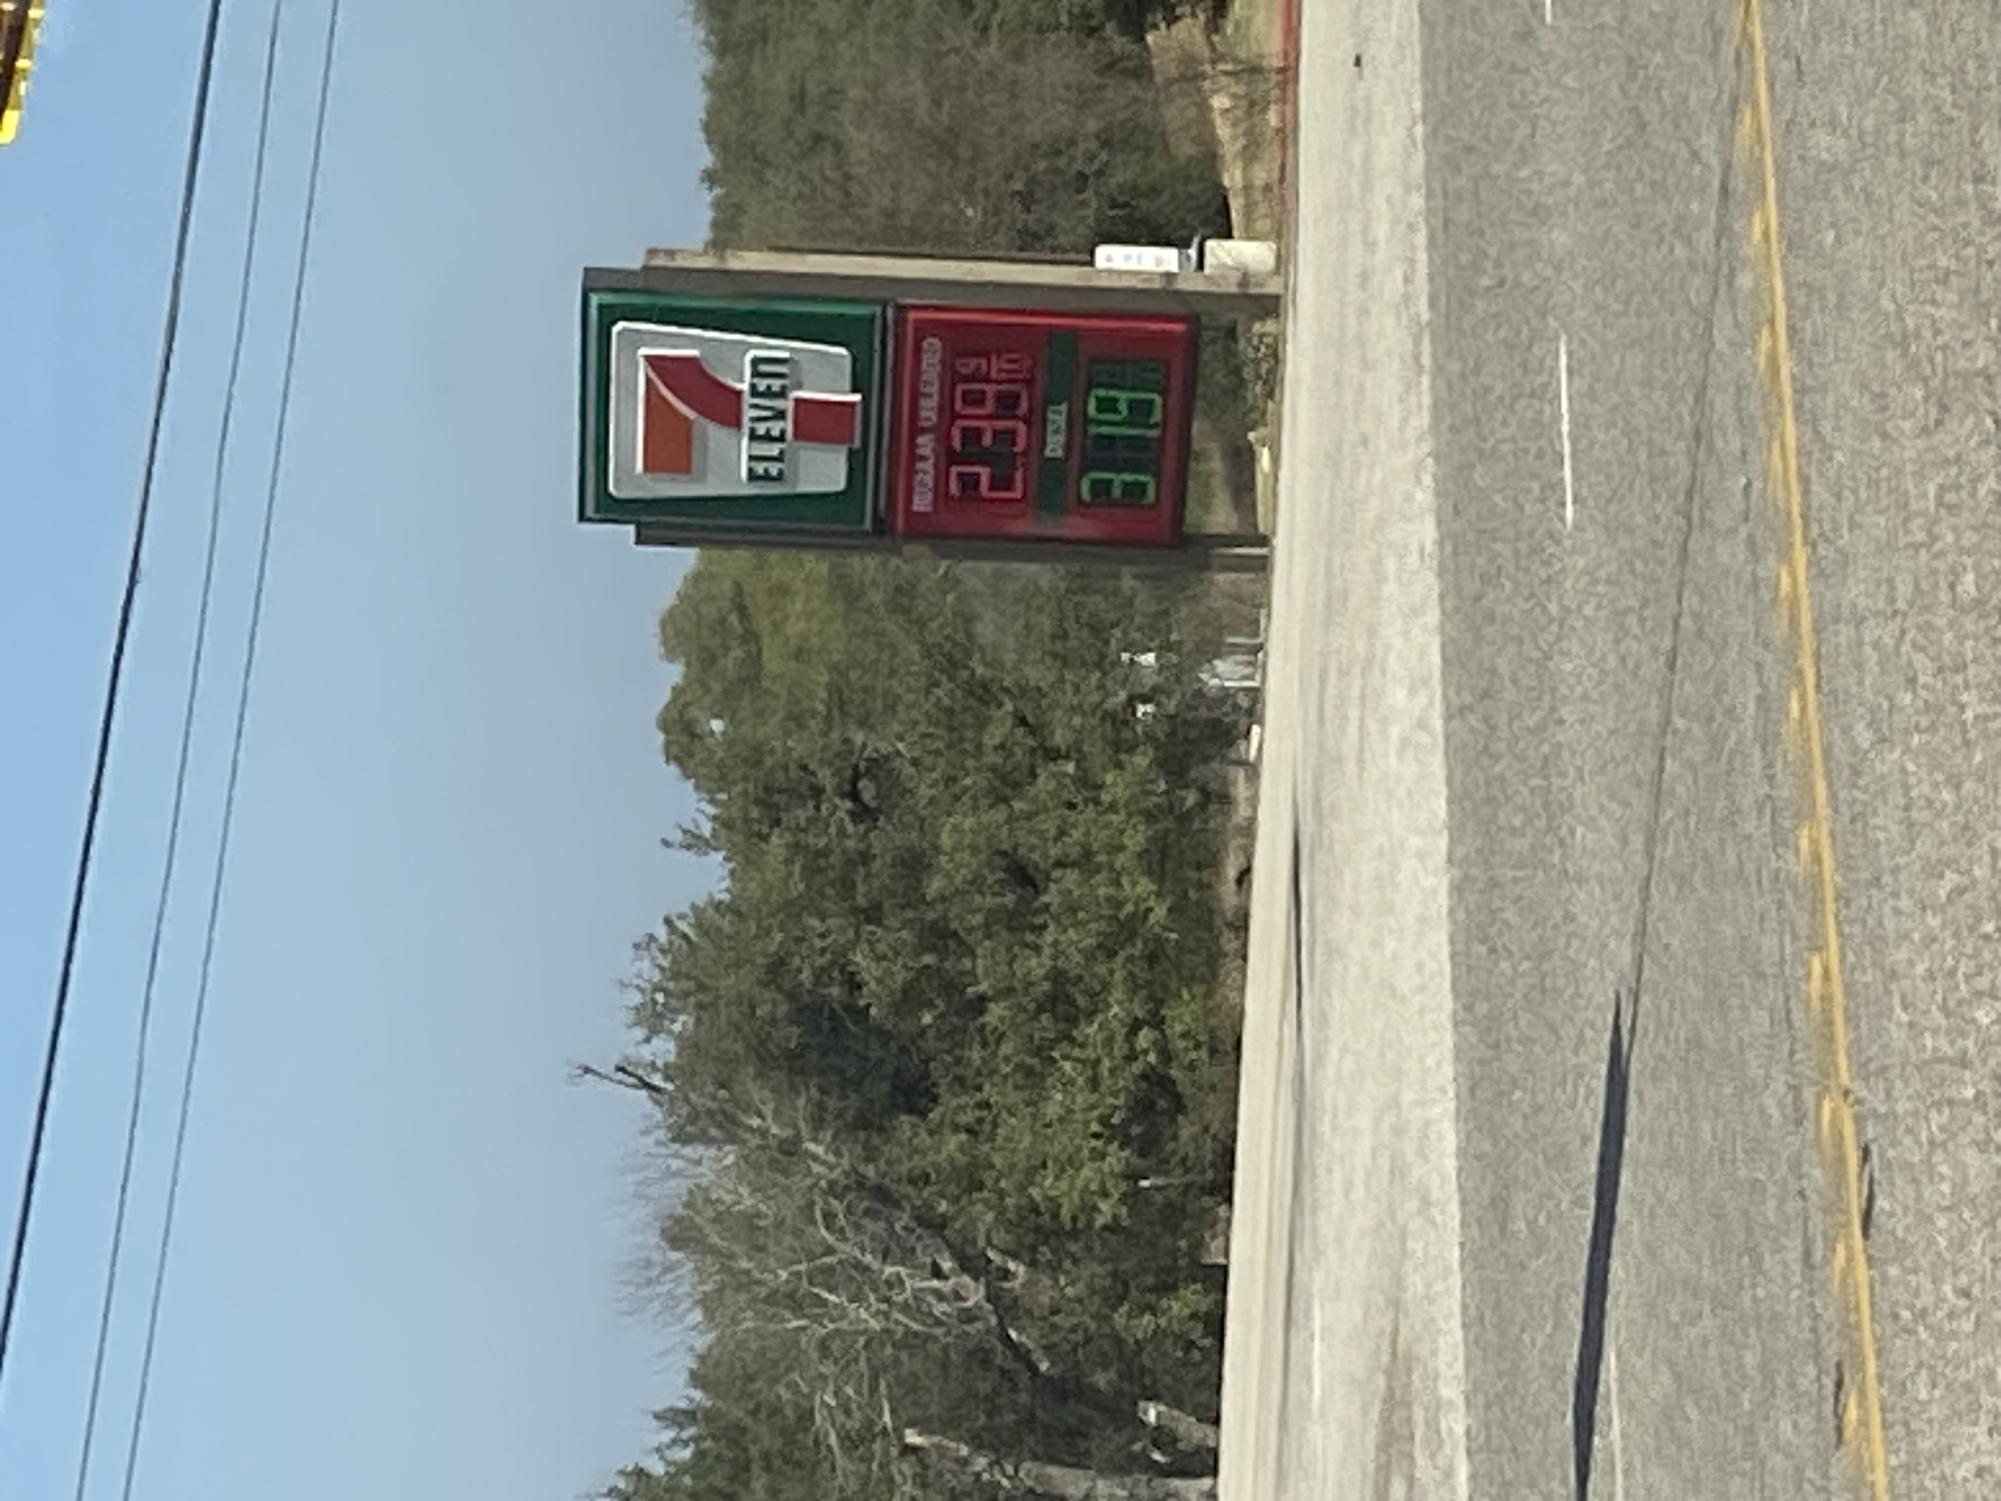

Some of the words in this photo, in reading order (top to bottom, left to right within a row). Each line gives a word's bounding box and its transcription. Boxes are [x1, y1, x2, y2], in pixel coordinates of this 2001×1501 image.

[636, 347, 863, 476] 7
[918, 337, 942, 427] UNLEADED
[912, 433, 936, 513] REGULAR
[1044, 402, 1068, 459] DIESEL
